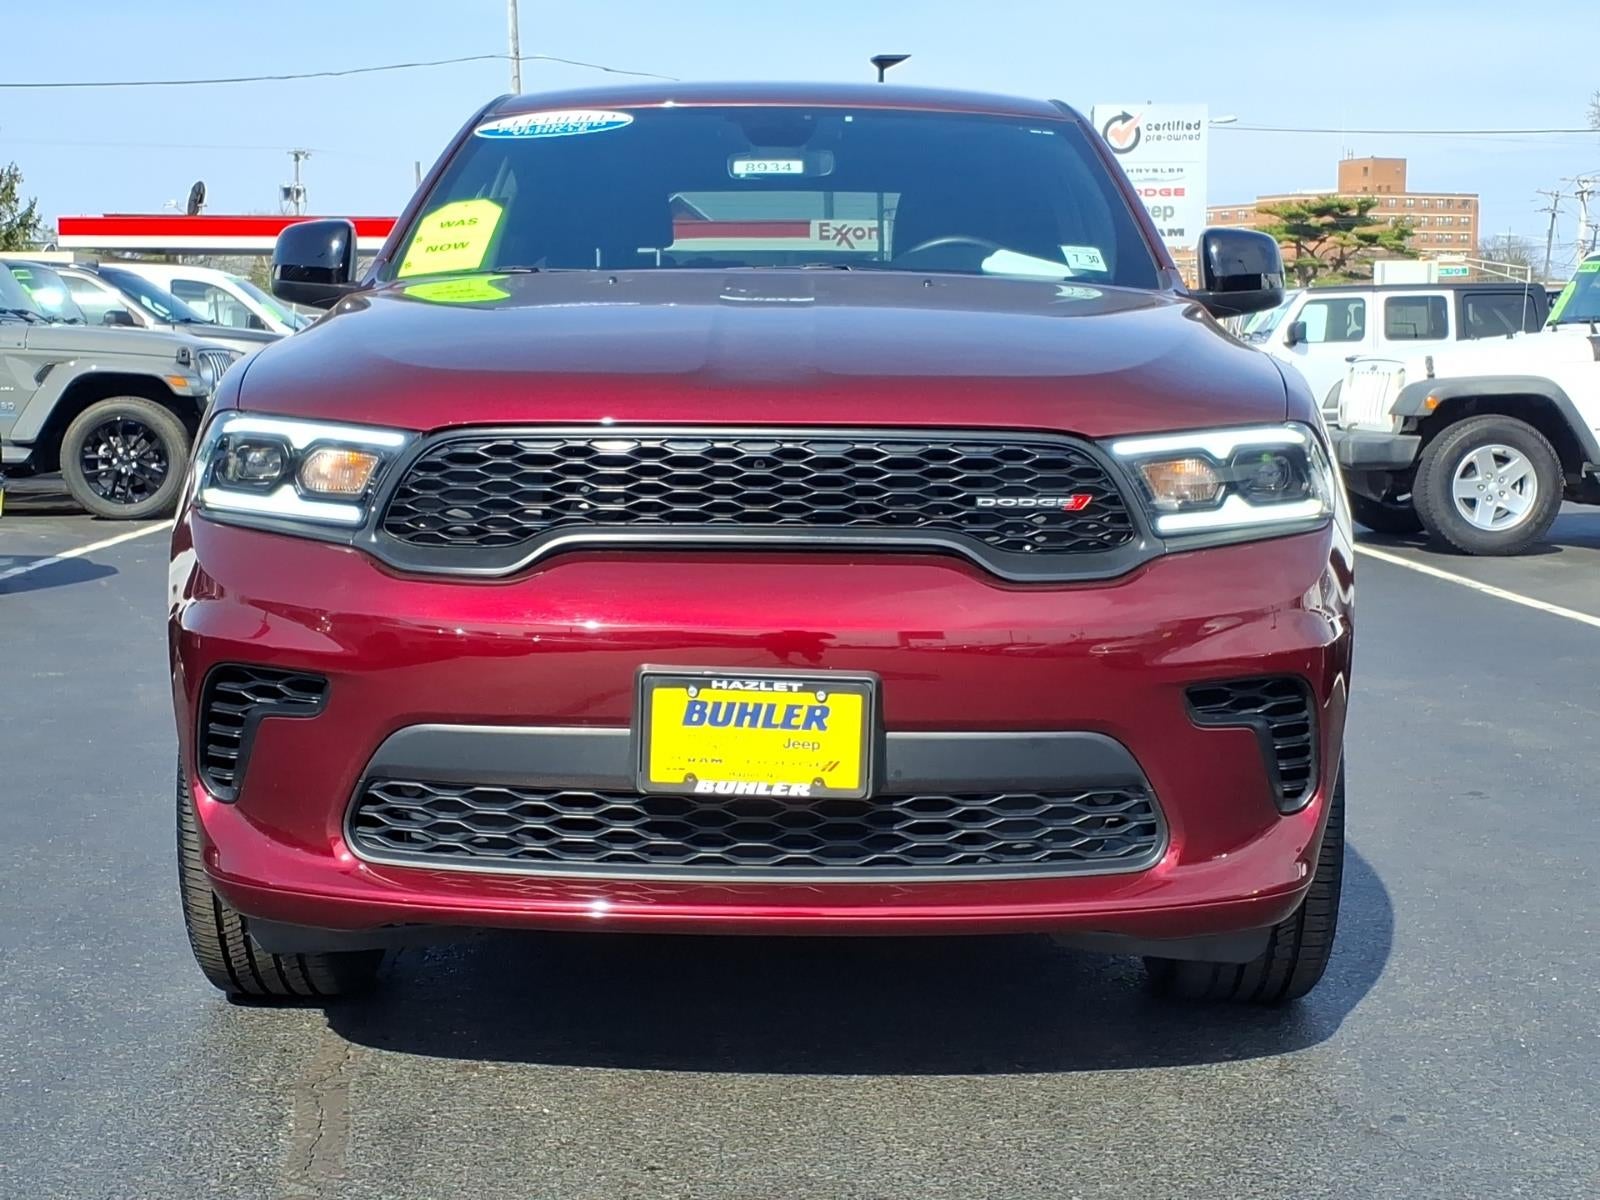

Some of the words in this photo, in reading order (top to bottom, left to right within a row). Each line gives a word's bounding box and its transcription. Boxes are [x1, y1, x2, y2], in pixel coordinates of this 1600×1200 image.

[1146, 120, 1201, 131] certified
[1145, 132, 1201, 143] pre-owned
[745, 162, 792, 172] 8934
[1136, 188, 1185, 197] DGE
[440, 217, 479, 229] WAS
[818, 222, 880, 250] Exxon
[425, 241, 470, 253] NOW
[976, 497, 1074, 507] DODGE
[711, 679, 803, 692] HAZLET
[682, 699, 830, 732] BUHLER
[783, 738, 821, 751] Jeep
[694, 779, 812, 796] BUHLER
